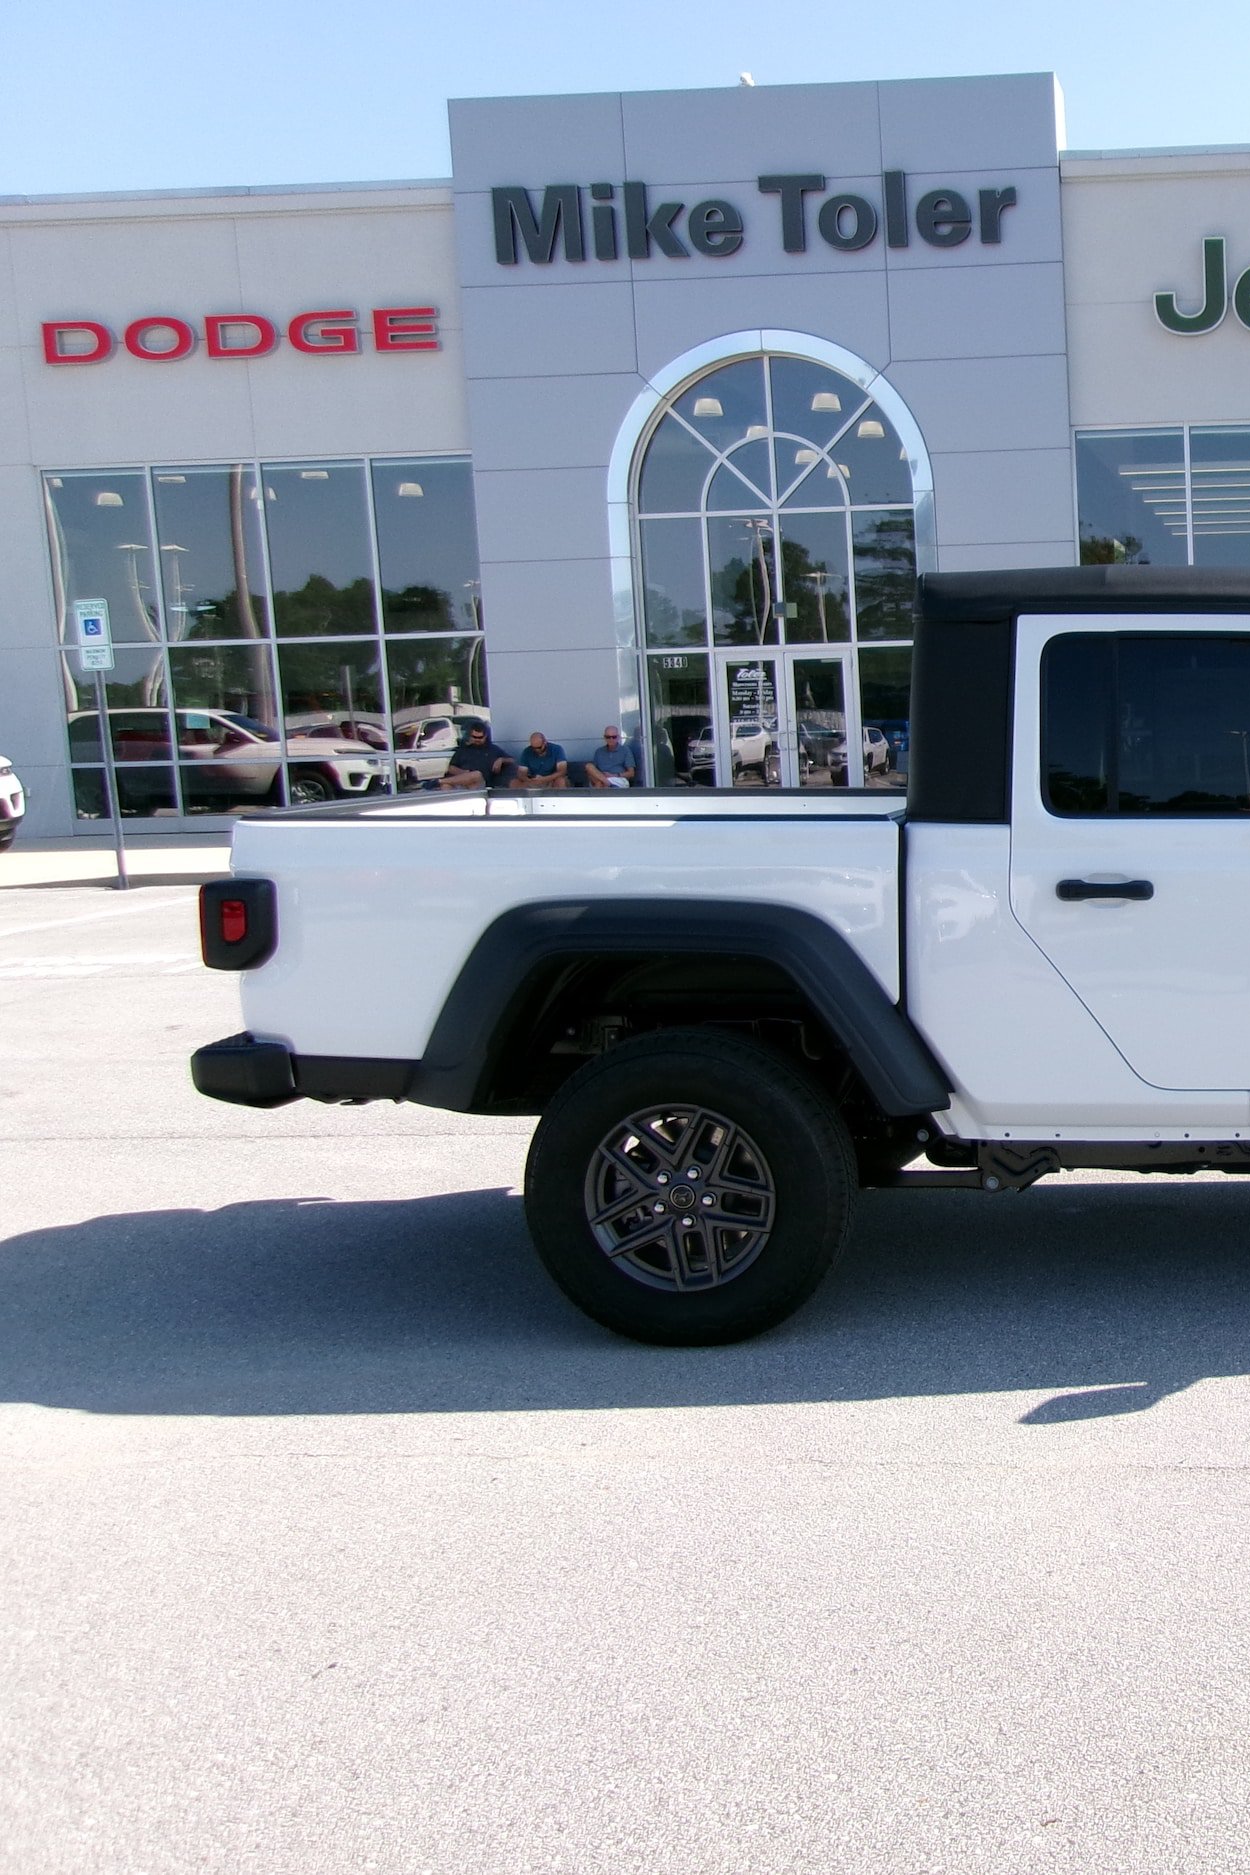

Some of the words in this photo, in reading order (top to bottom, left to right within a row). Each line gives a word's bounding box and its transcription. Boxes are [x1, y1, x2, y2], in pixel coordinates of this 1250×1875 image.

[491, 181, 744, 265] Mike
[757, 170, 1017, 253] Toler
[41, 306, 441, 366] DODGE
[663, 656, 688, 668] 5340
